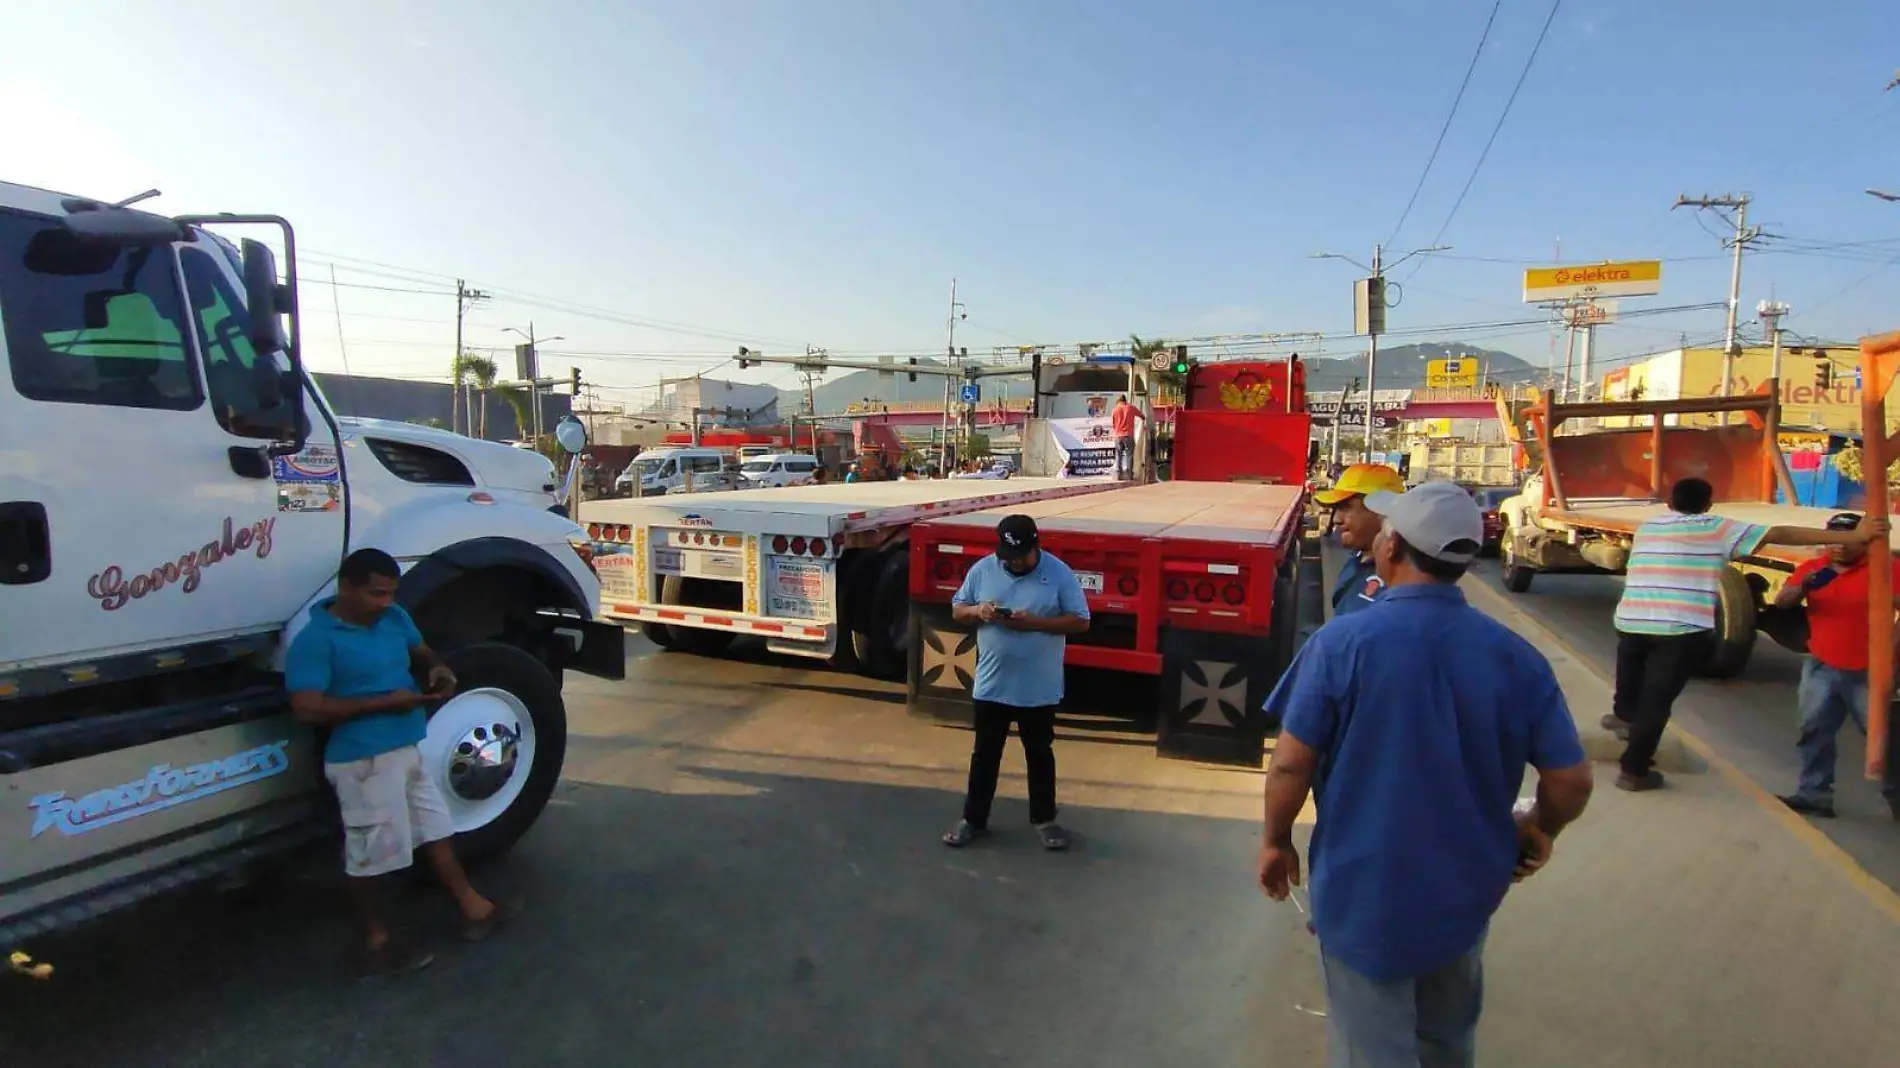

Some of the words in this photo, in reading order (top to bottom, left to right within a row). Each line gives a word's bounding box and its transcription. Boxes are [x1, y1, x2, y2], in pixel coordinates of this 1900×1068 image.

[1573, 268, 1630, 282] elektra
[1777, 379, 1862, 404] lektr
[1350, 401, 1408, 412] POABLE
[88, 516, 275, 611] Gonzalez
